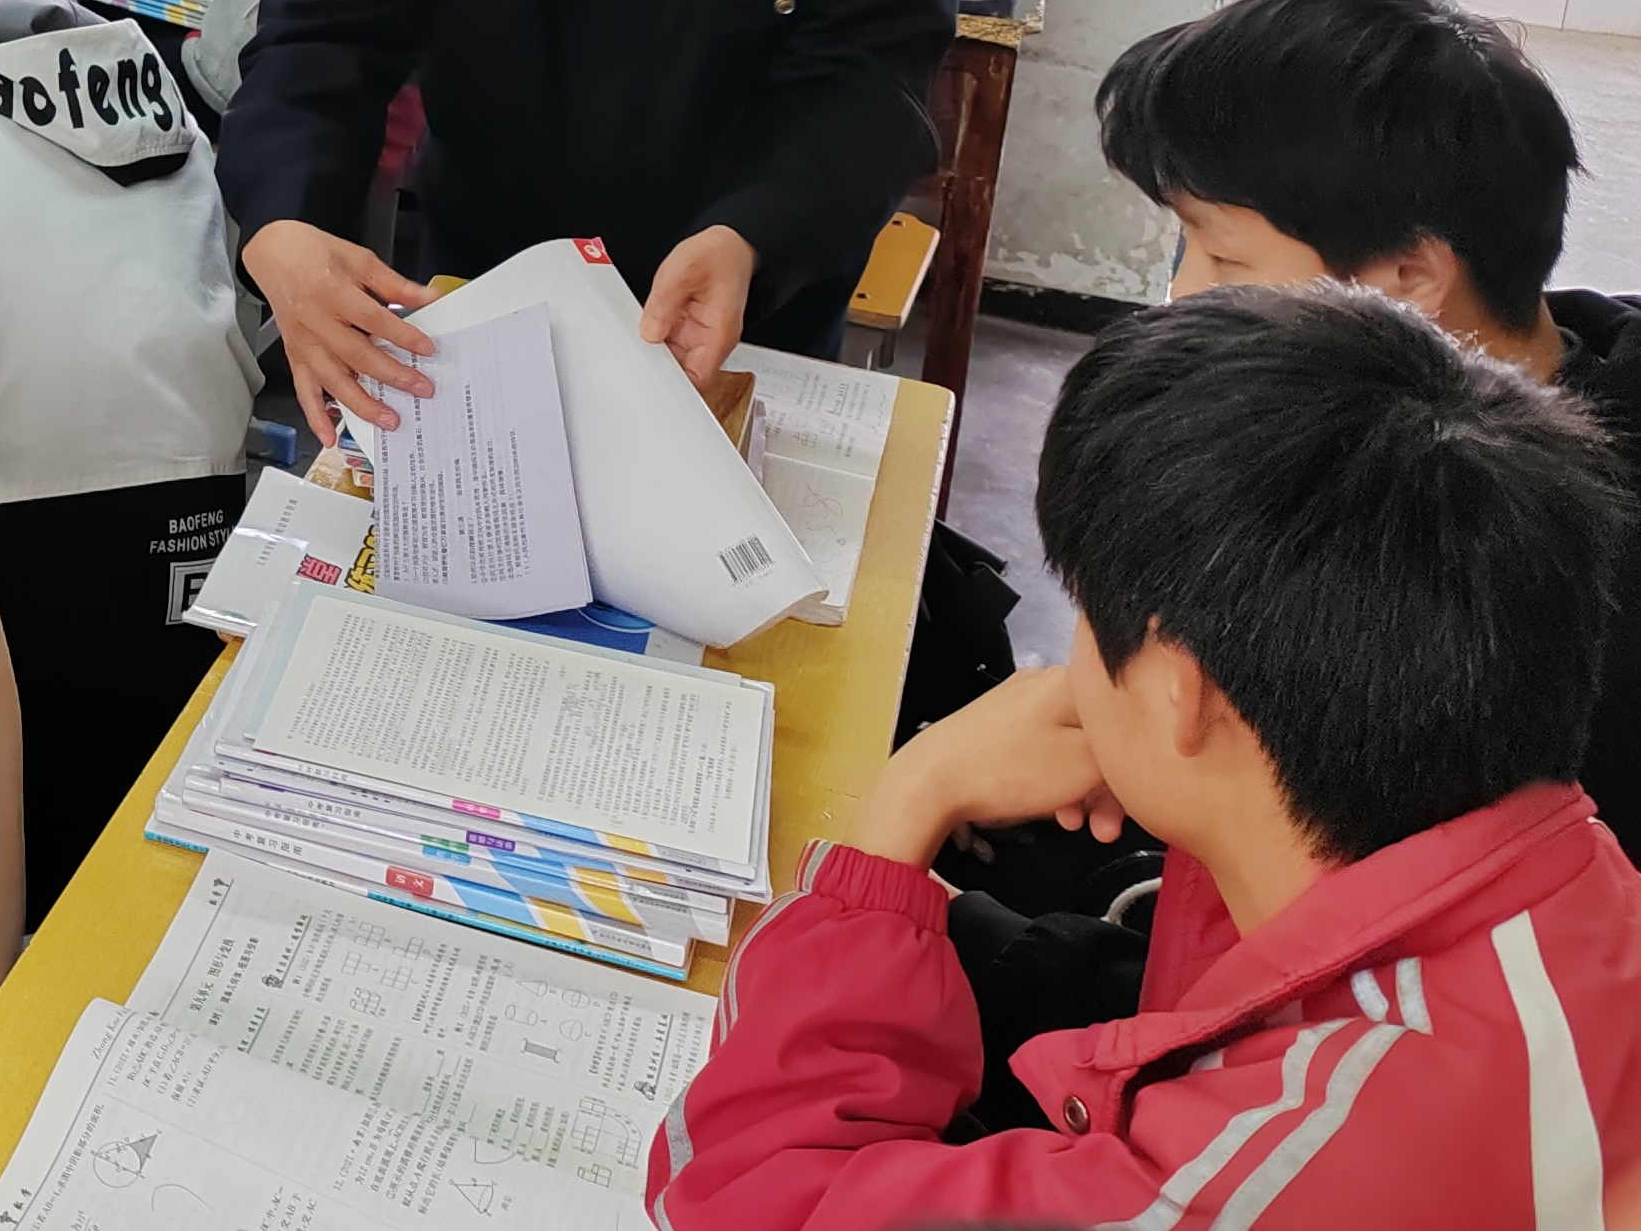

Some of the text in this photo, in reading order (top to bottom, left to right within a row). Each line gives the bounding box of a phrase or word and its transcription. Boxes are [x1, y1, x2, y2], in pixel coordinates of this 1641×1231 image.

[168, 509, 224, 534] BAOFENG
[149, 534, 208, 554] FASHION
[306, 797, 362, 821] 中考复习指南
[230, 827, 304, 857] 中考复习指南
[391, 871, 428, 892] 语文
[188, 935, 236, 1013] 第九单元 图形与变换
[90, 1029, 112, 1060] Zhong
